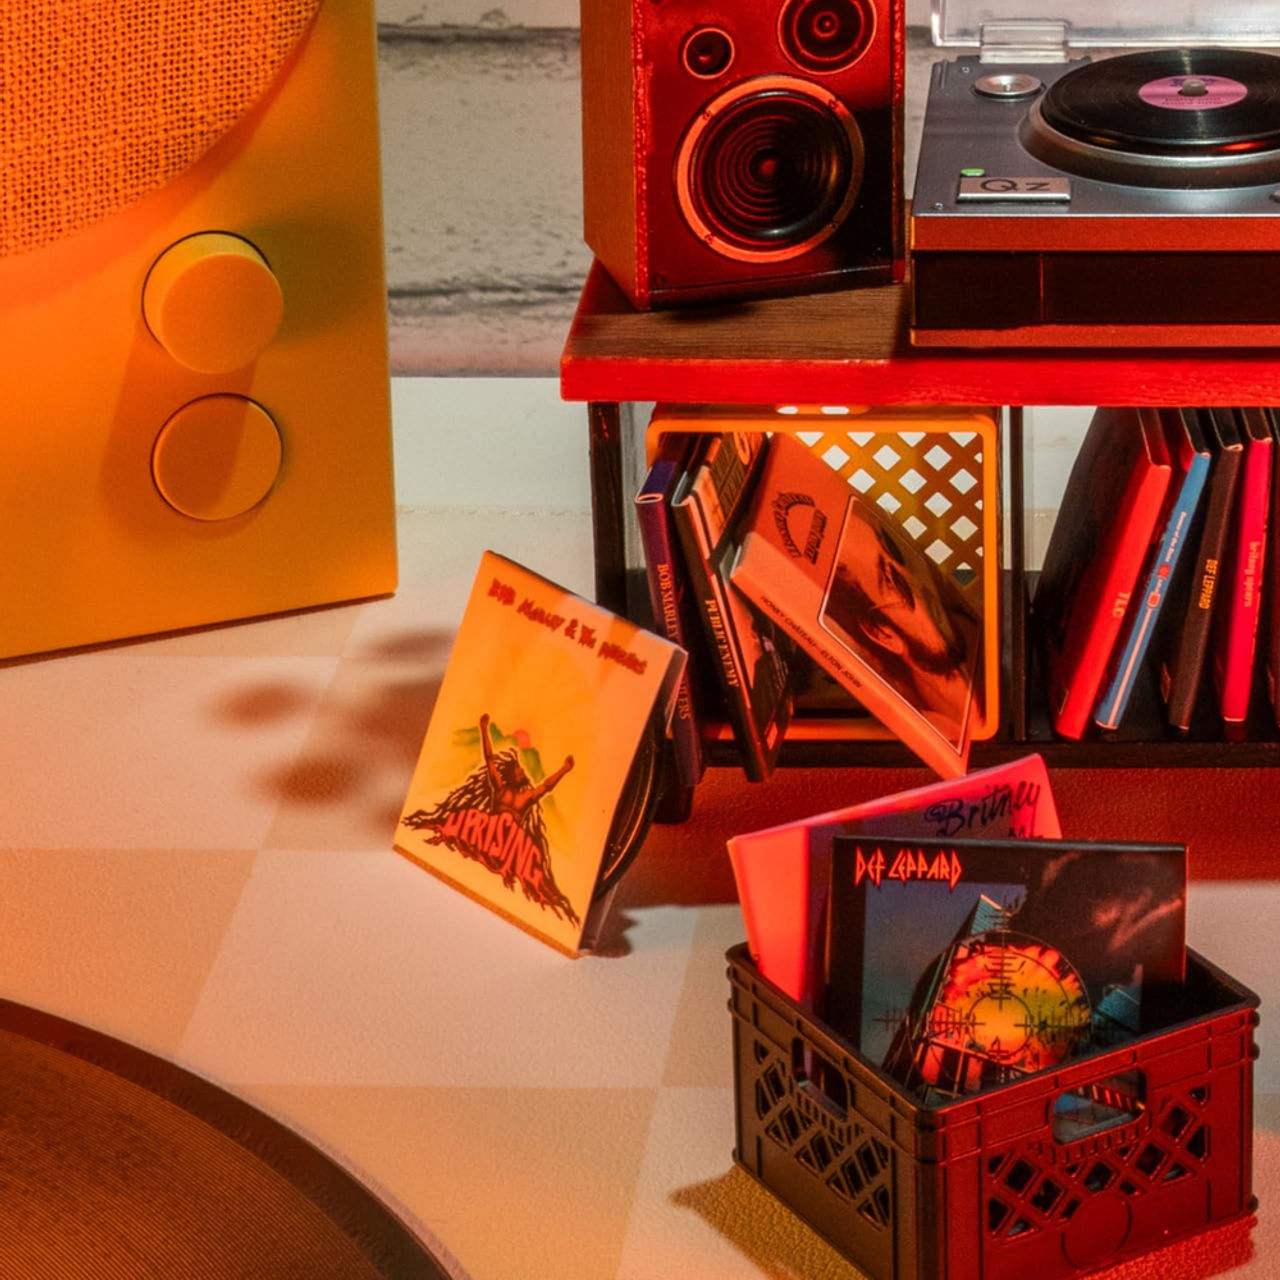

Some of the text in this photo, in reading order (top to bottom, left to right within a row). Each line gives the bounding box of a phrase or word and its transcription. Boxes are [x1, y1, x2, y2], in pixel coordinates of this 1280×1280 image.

[657, 562, 675, 590] BOB
[1198, 559, 1219, 609] DEF LEPPARD
[662, 588, 682, 640] MARLEY
[1112, 591, 1131, 617] TLC
[705, 599, 740, 688] PUBLIC ENEMY
[924, 780, 1041, 838] Britney
[442, 808, 543, 887] UPRISING
[854, 845, 963, 892] DEF LEPPARD
